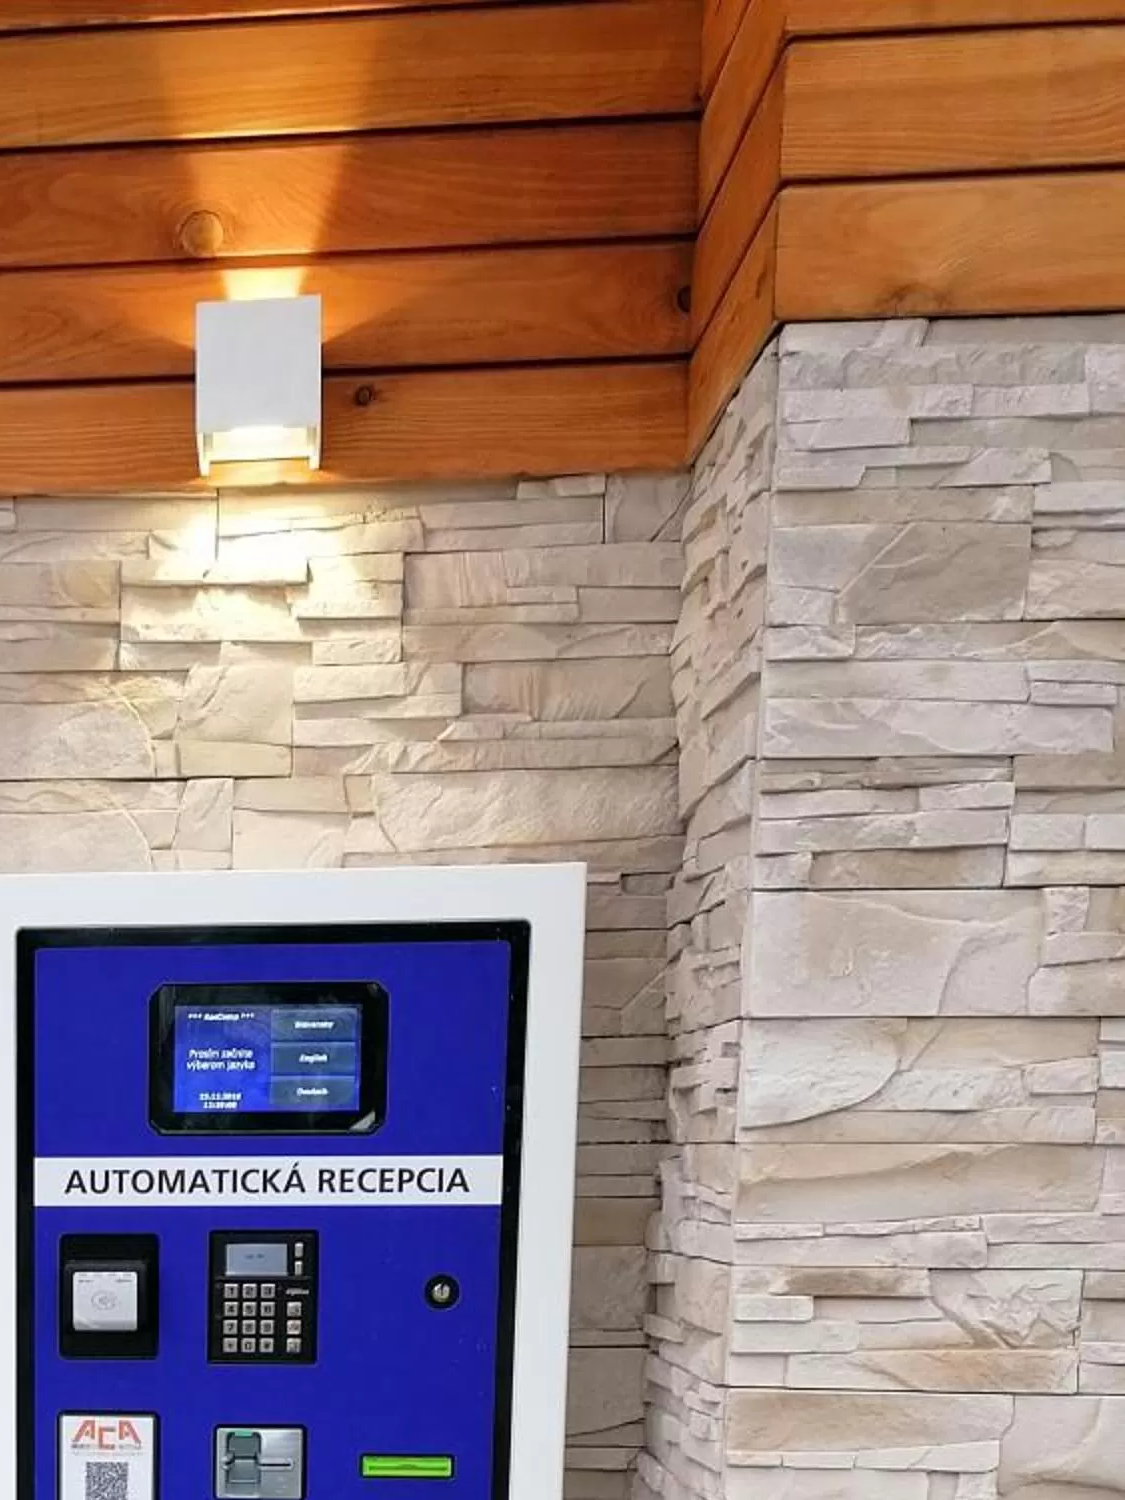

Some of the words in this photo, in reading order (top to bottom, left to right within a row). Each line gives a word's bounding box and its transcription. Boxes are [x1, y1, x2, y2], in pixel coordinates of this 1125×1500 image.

[65, 1161, 306, 1195] AUTOMATICKÁ
[318, 1167, 470, 1193] RECEPCIA
[72, 1419, 142, 1450] ACA
